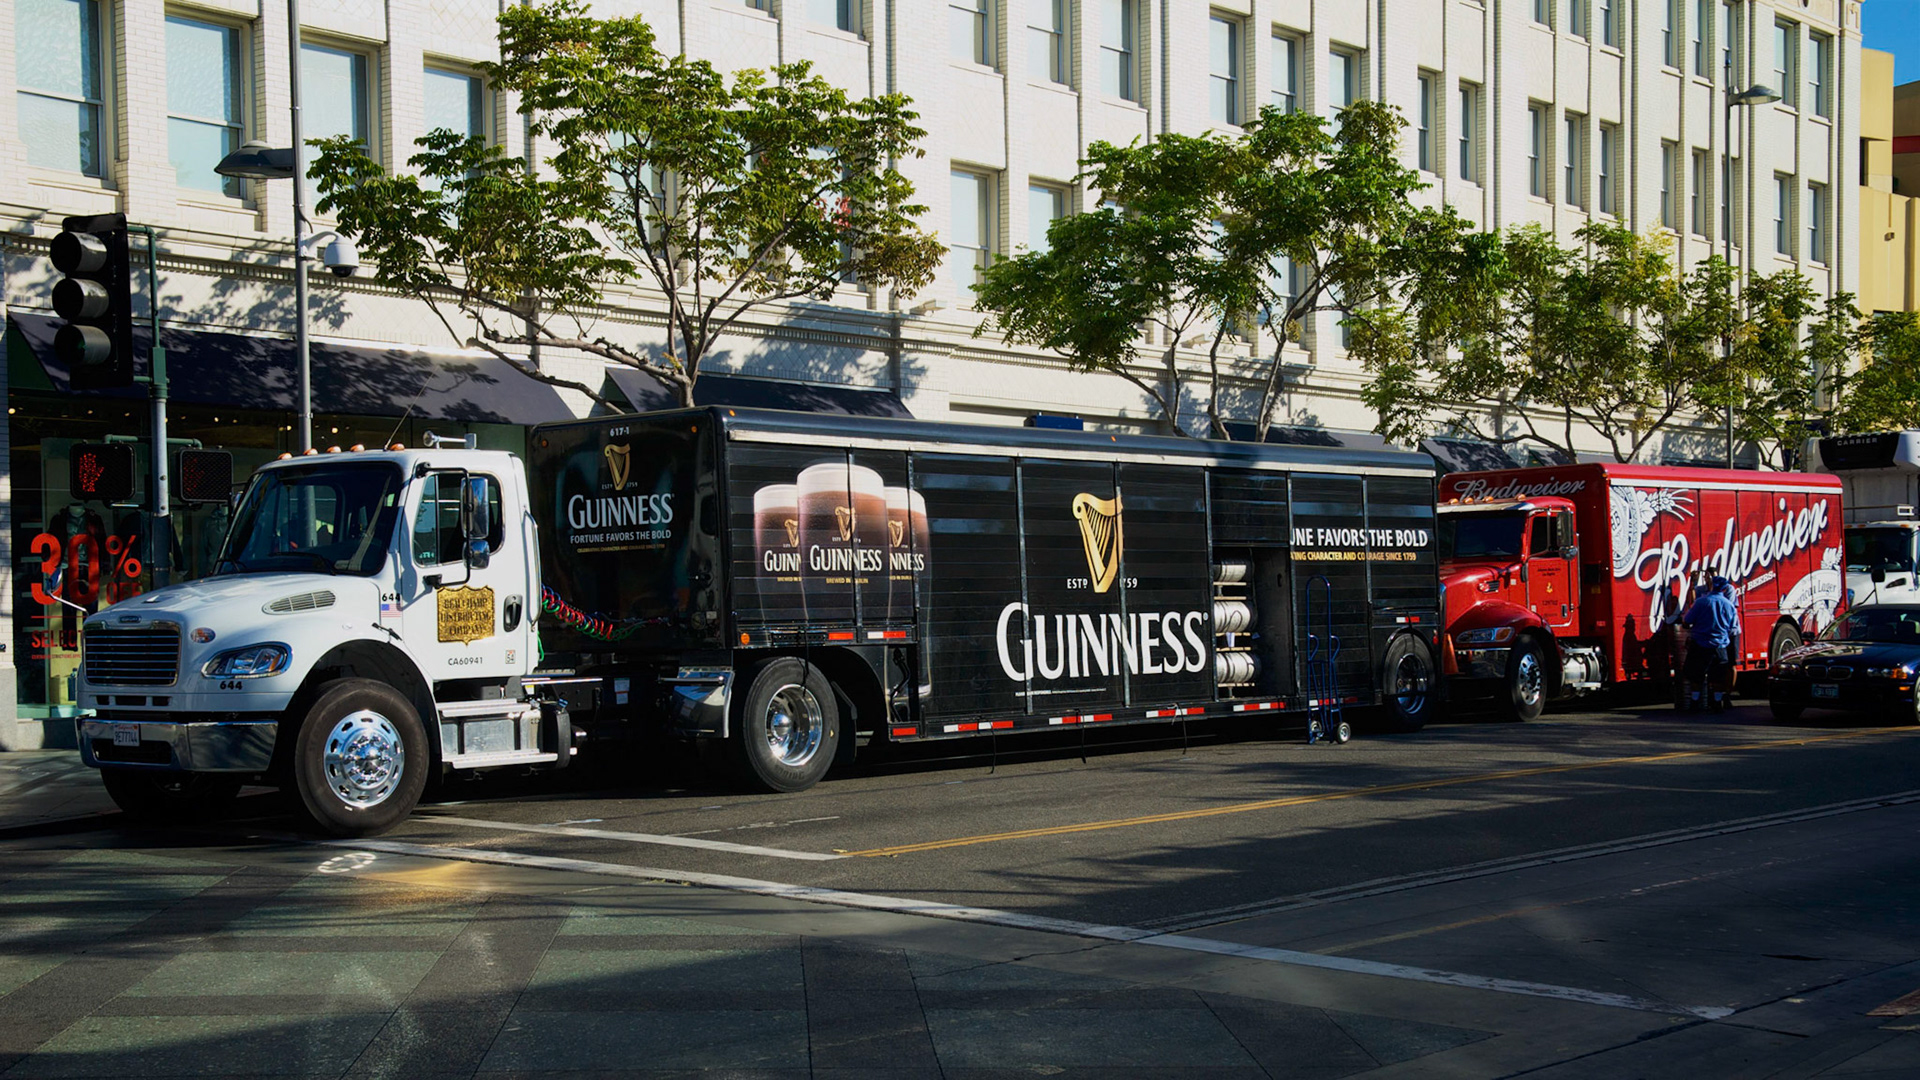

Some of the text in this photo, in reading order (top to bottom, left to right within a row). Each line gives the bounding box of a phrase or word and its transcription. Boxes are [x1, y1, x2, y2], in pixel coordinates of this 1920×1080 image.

[609, 426, 630, 437] 617-1
[1836, 437, 1878, 447] CARRIER
[1453, 476, 1586, 503] Budweiser
[570, 529, 672, 545] FORTUNE FAVORS THE BOLD
[1317, 528, 1367, 547] FAVORS
[1368, 529, 1393, 547] THE
[1396, 530, 1428, 547] BOLD
[809, 545, 882, 572] GUINNESS
[1306, 552, 1342, 561] CHARACTER
[1342, 552, 1356, 561] AND
[381, 593, 401, 602] 644
[996, 601, 1208, 682] GUINNESS
[447, 657, 483, 666] CA60941
[219, 680, 243, 690] 644
